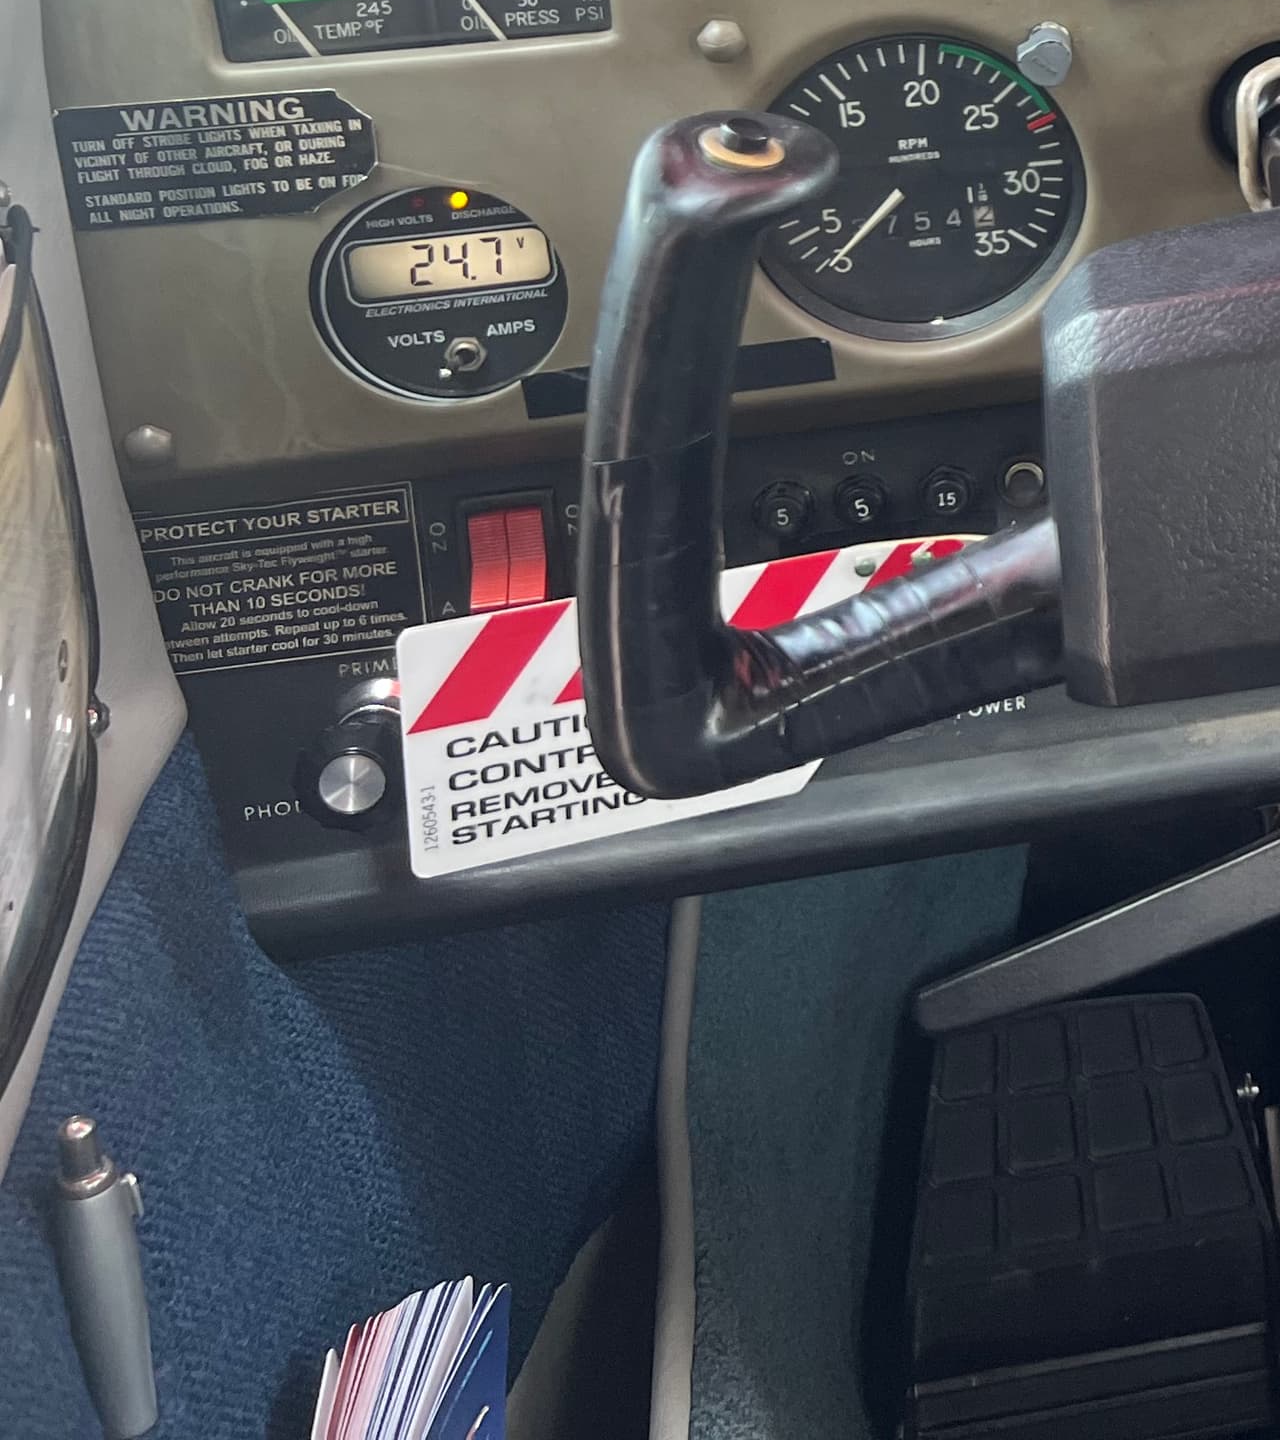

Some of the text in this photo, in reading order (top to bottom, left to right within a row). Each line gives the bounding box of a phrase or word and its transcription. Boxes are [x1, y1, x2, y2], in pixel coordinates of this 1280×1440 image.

[505, 9, 560, 27] PRESS
[904, 80, 940, 107] 20
[121, 98, 305, 132] WARNING
[964, 105, 999, 131] 25
[898, 138, 928, 150] RPM
[410, 237, 503, 287] 24.7
[388, 330, 445, 349] VOLTS
[487, 319, 536, 337] AMPS
[141, 500, 400, 543] PROTECT YOUR STARTER
[154, 562, 398, 603] DO NOT CRANK FOR MORE
[190, 584, 365, 616] THAN 10 SECONDS!
[450, 772, 619, 821] REMOVE
[451, 791, 647, 845] STARTING
